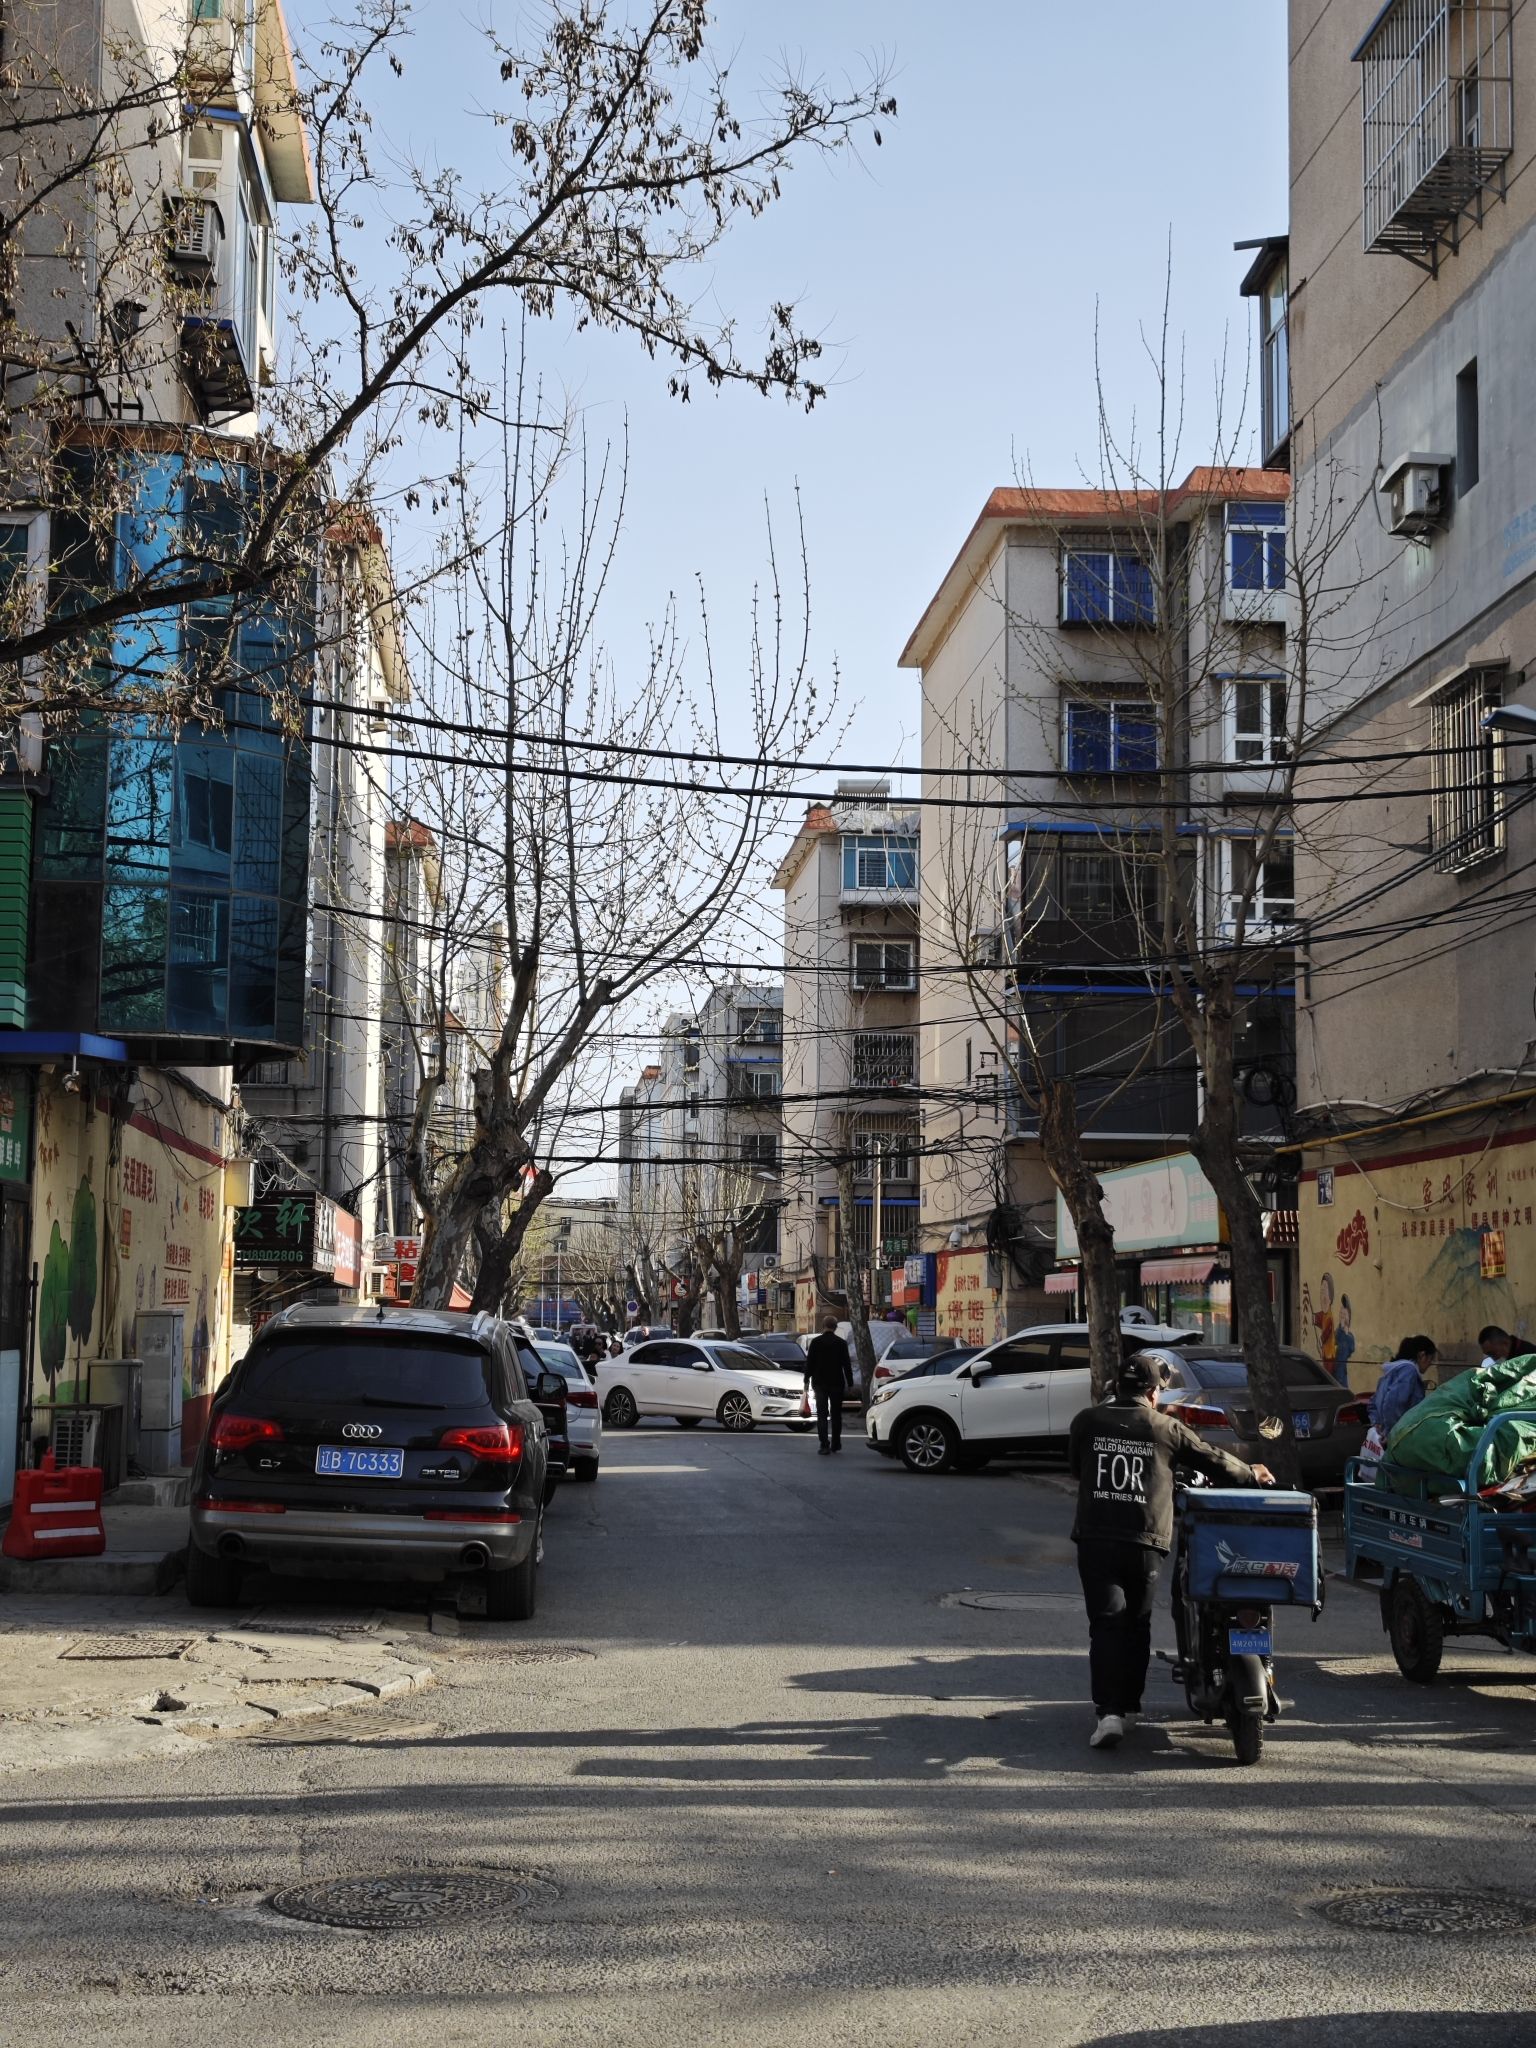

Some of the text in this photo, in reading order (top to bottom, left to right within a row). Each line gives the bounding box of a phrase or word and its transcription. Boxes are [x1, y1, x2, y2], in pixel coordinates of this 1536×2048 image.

[1093, 1442, 1117, 1452] CALLED
[260, 1458, 281, 1467] Q7
[1097, 1453, 1144, 1492] FOR
[1093, 1490, 1147, 1503] TIME TRIES ALL
